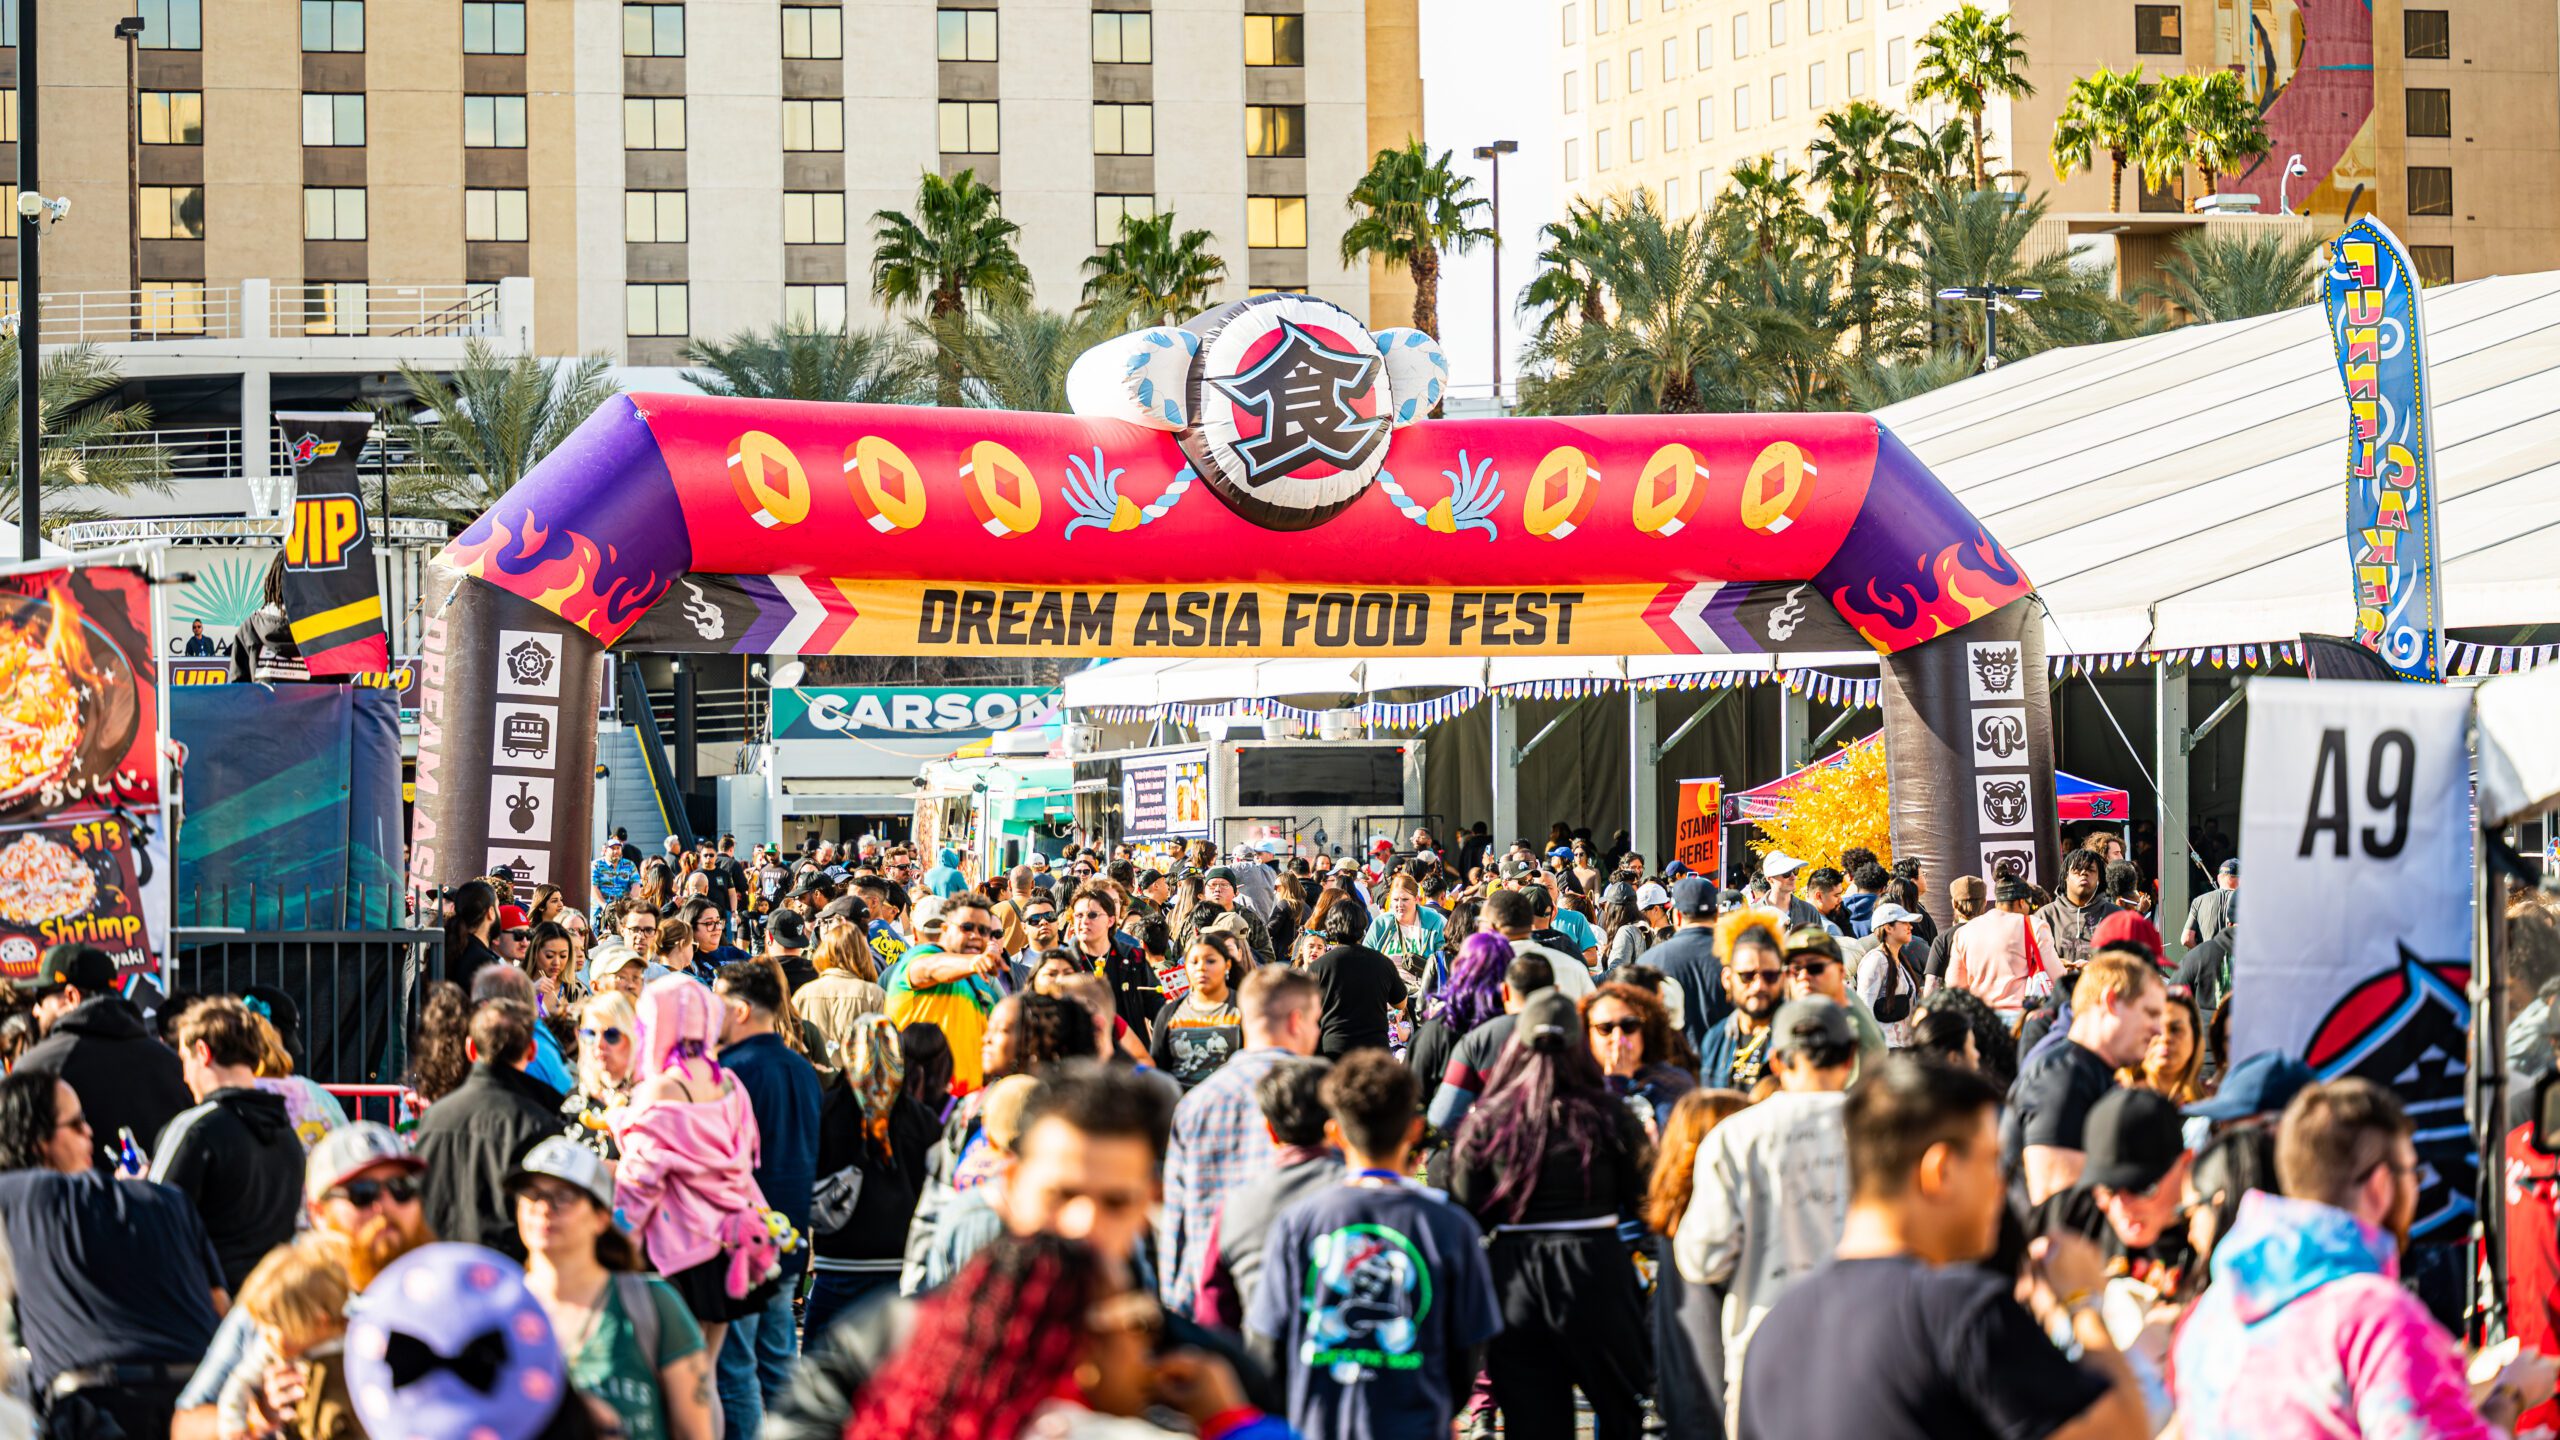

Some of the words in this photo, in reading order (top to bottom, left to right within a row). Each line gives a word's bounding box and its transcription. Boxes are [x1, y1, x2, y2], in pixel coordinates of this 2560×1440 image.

[1208, 317, 1389, 486] 食
[285, 500, 358, 565] VIP
[918, 589, 1118, 646] DREAM
[1133, 591, 1262, 647] ASIA
[1282, 592, 1431, 647] FOOD
[1449, 592, 1585, 646] FEST
[808, 693, 1062, 731] CARSON
[2297, 728, 2416, 860] A9
[72, 821, 124, 854] $13
[1680, 812, 1717, 841] STAMP
[1679, 840, 1713, 865] HERE!
[39, 913, 142, 948] Shrimp
[106, 949, 145, 970] yaki
